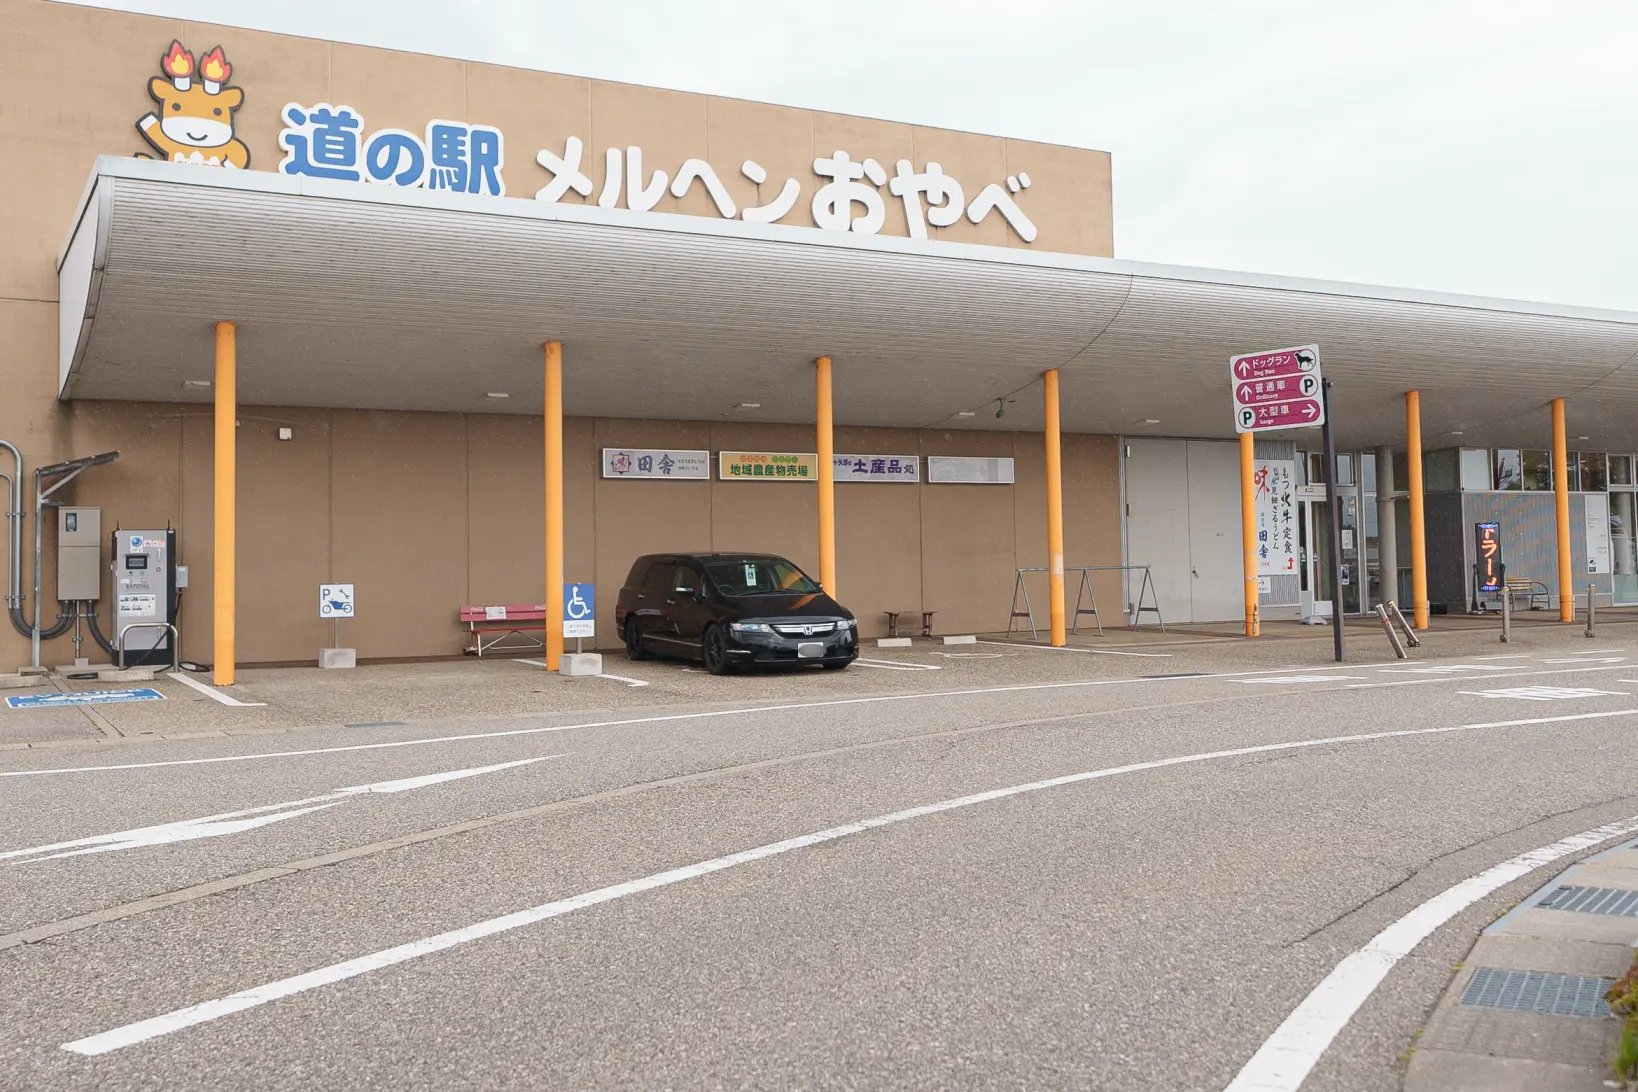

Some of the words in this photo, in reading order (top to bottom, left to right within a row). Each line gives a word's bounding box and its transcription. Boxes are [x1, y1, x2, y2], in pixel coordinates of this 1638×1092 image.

[280, 103, 504, 196] 道の駅
[1252, 355, 1291, 369] ドッグラン
[1255, 380, 1286, 393] 普通車
[1304, 378, 1314, 394] P
[1243, 411, 1253, 425] P
[1258, 404, 1290, 418] 大型車
[637, 453, 675, 475] 田舎
[730, 463, 808, 477] 地域農産物売場
